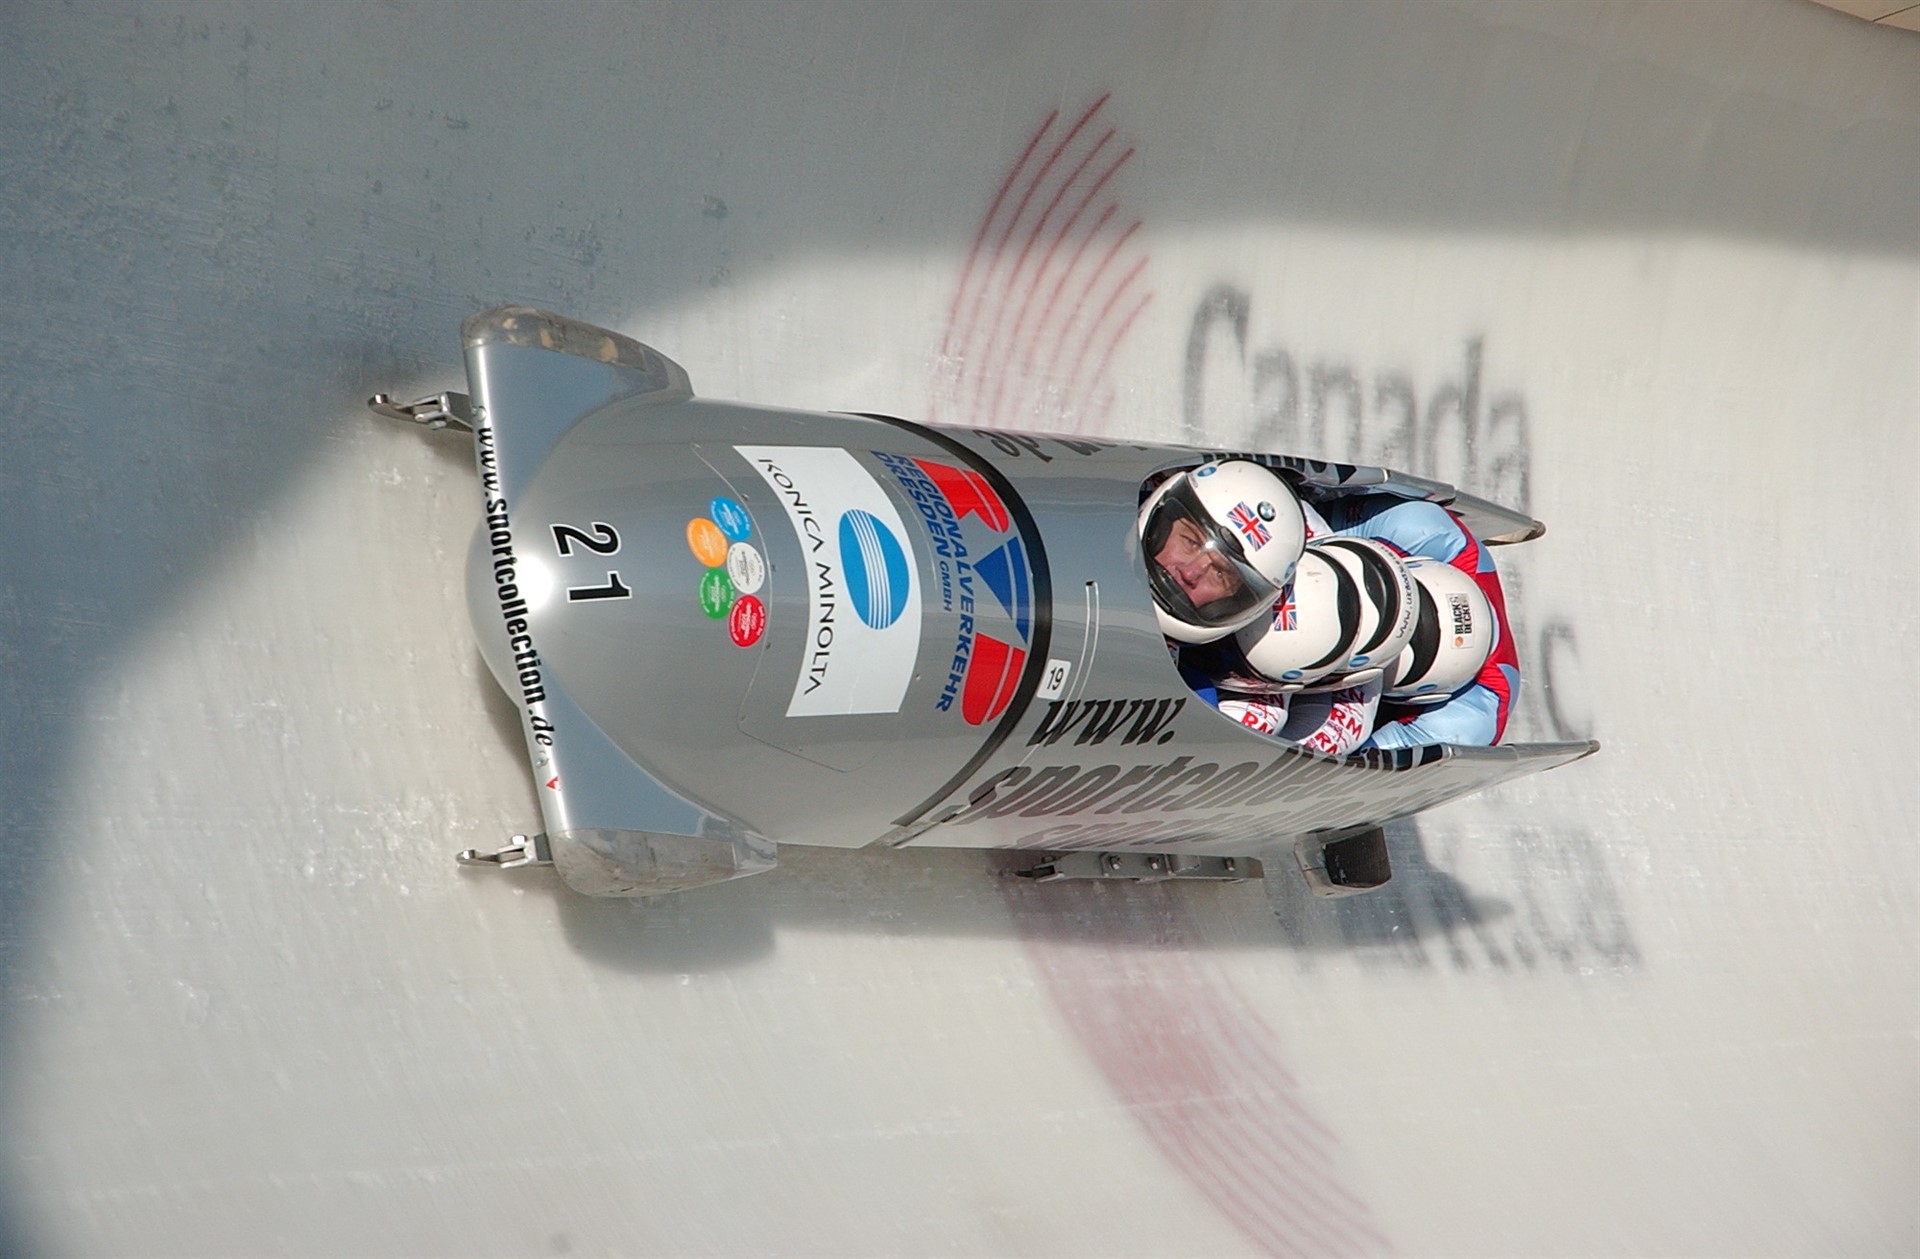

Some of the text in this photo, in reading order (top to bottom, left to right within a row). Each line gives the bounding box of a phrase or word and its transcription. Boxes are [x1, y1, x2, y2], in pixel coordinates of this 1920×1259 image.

[871, 450, 952, 565] DRESDEN
[549, 521, 632, 603] 21
[758, 457, 836, 696] KONICA MINOLTA
[891, 453, 975, 713] REGIONALVERKEHR
[1025, 698, 1187, 748] www.
[1046, 666, 1064, 691] 19
